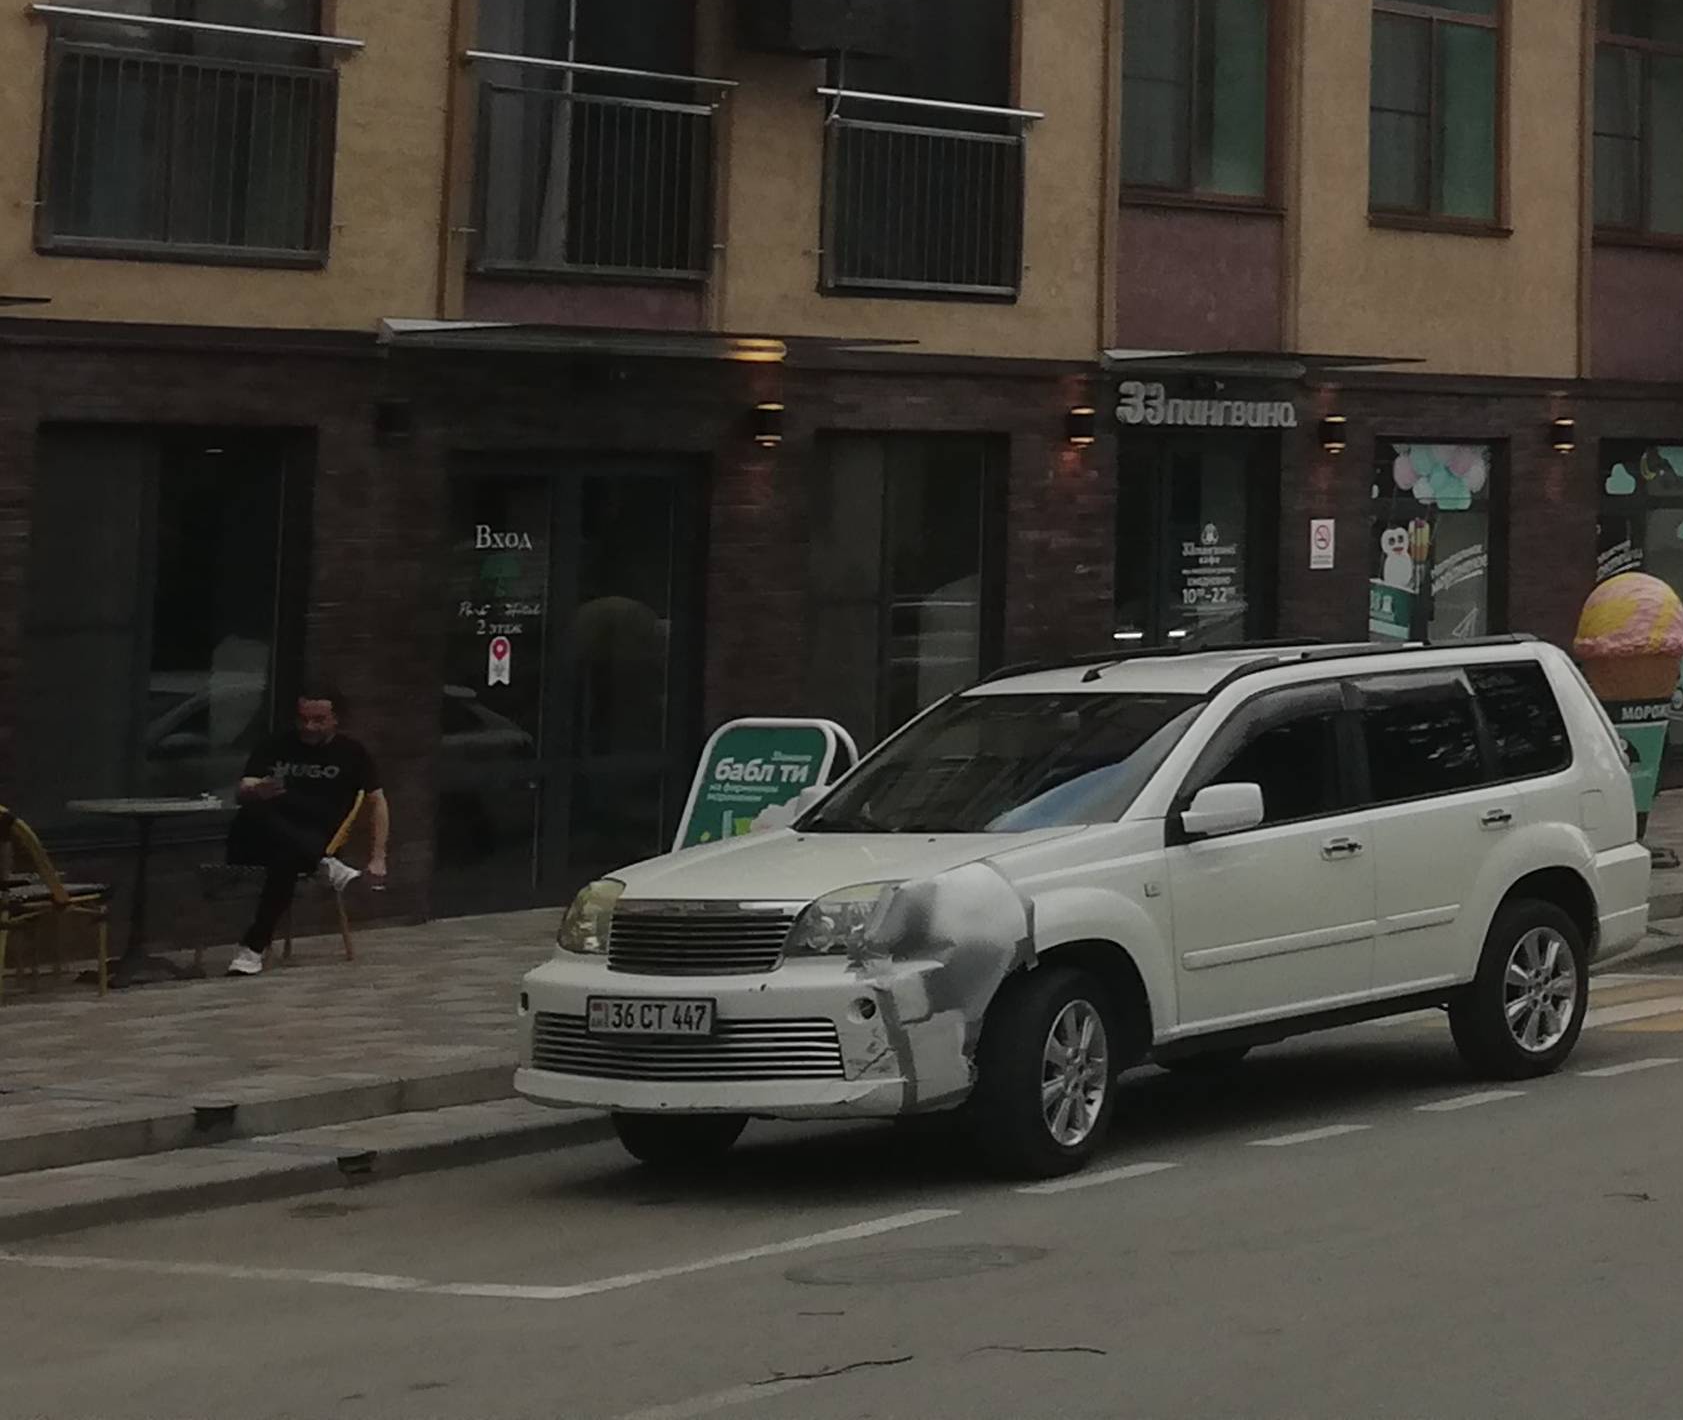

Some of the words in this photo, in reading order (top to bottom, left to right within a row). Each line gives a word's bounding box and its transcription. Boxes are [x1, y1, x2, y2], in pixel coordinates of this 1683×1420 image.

[475, 524, 533, 551] Вход
[476, 619, 486, 635] 2
[715, 757, 775, 782] бабл
[780, 764, 809, 783] ти
[612, 1003, 634, 1029] 36
[640, 1004, 667, 1030] CT
[672, 1004, 706, 1030] 447
